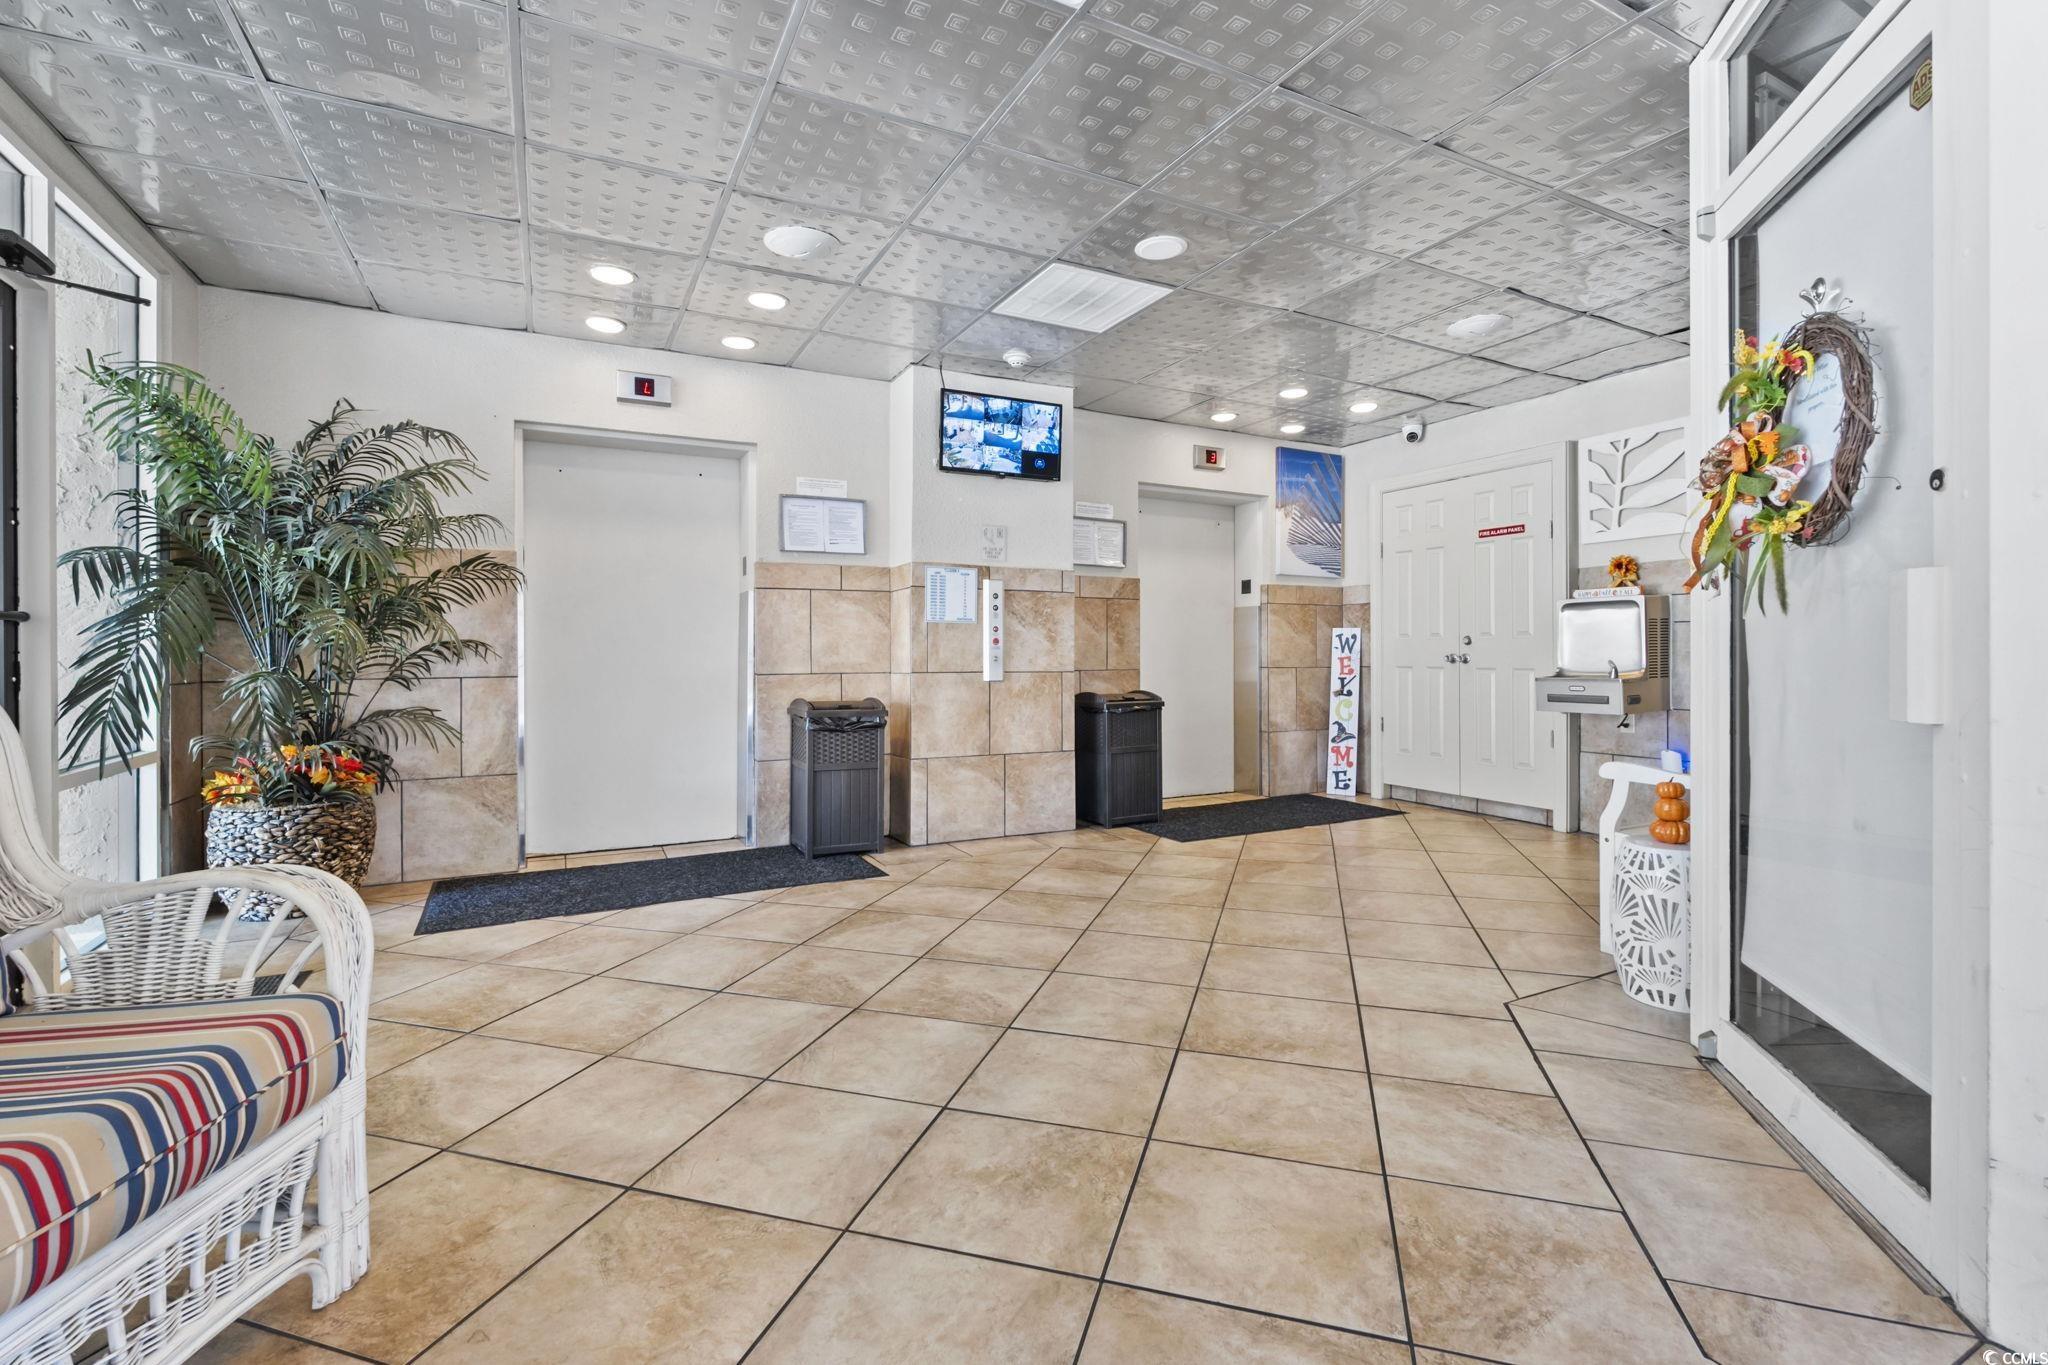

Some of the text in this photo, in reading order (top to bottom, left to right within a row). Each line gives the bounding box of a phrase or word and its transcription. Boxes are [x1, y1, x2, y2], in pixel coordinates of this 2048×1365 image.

[1490, 528, 1508, 536] ALARM
[1508, 526, 1525, 534] PANEL
[1330, 632, 1358, 791] WELCME
